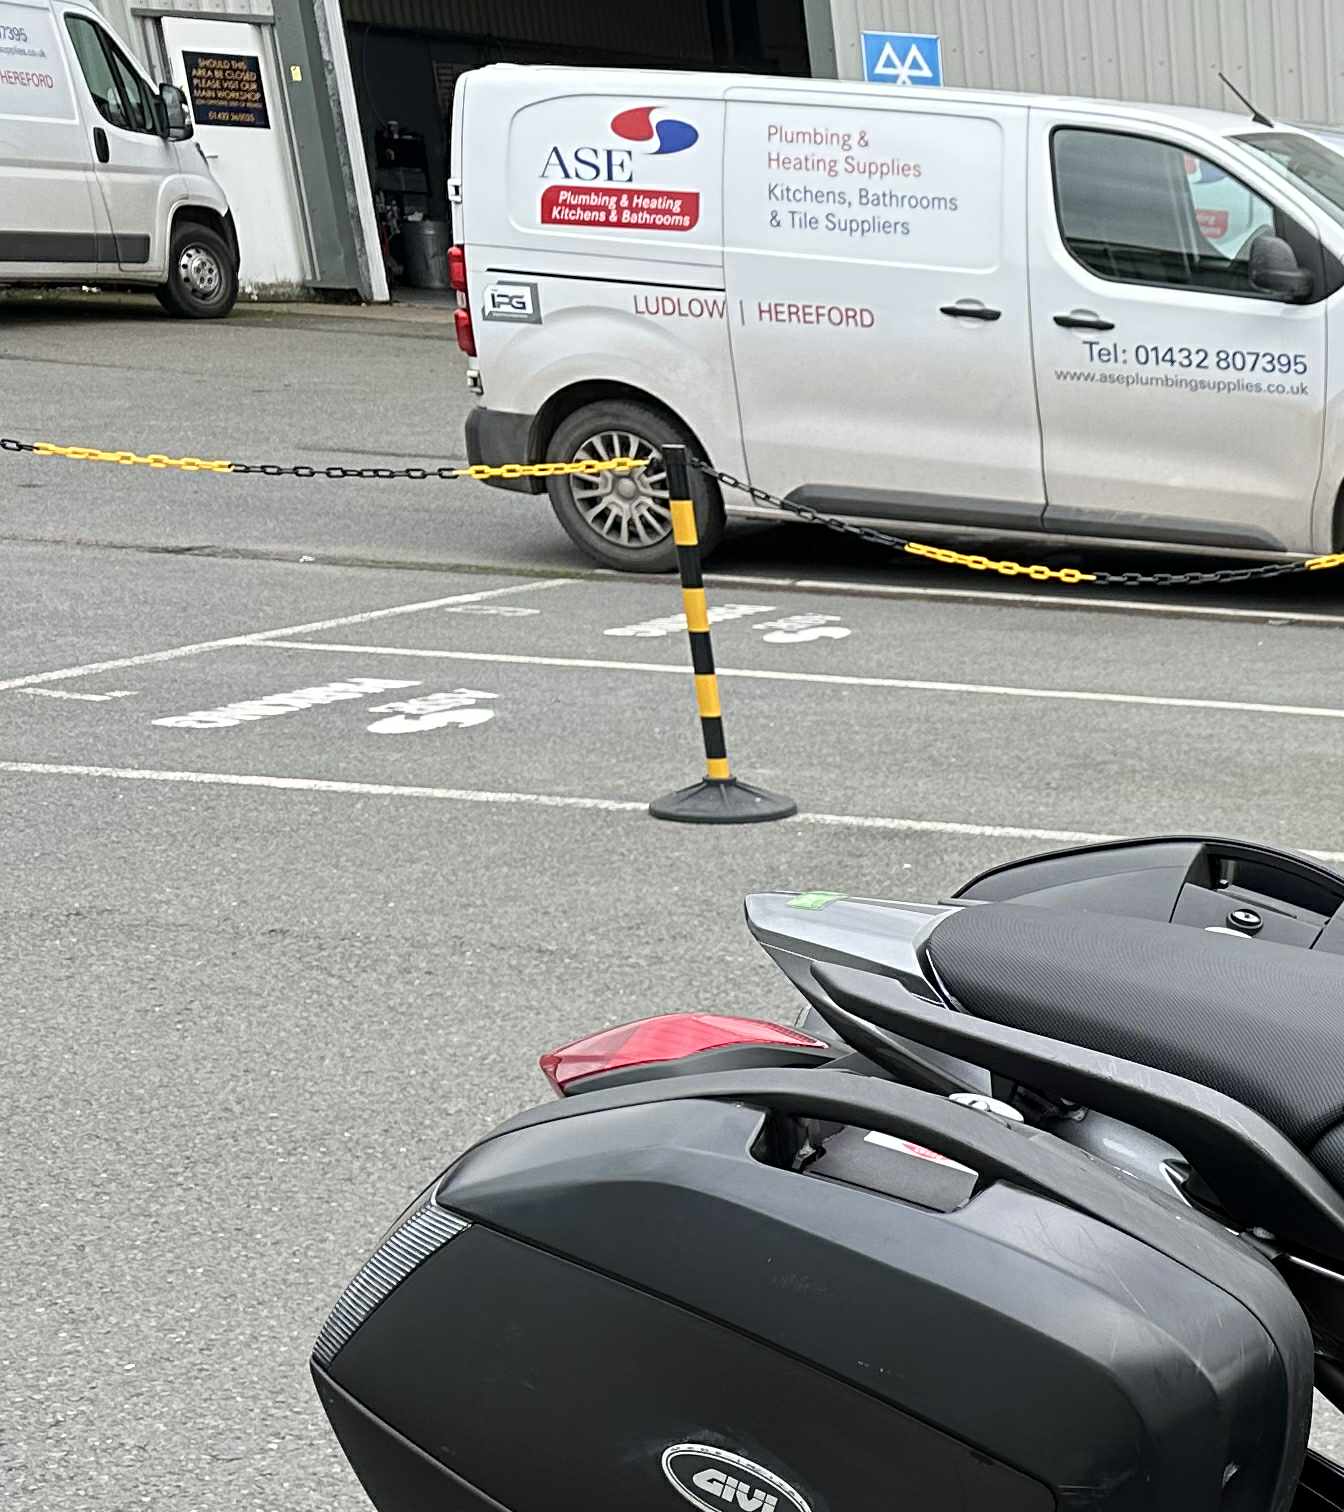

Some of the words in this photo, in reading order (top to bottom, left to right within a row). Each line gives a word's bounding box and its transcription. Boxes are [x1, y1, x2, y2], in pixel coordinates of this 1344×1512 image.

[0, 25, 28, 42] 7395
[768, 125, 852, 152] Plumbing
[857, 130, 869, 148] &
[538, 146, 633, 183] ASE
[768, 152, 838, 178] Heating
[844, 155, 922, 178] Supplies
[558, 190, 617, 210] Plumbing
[620, 194, 629, 204] &
[632, 195, 683, 213] Heating
[768, 183, 852, 208] Kitchens,
[858, 188, 959, 212] Bathrooms
[552, 206, 606, 222] Kitchens
[609, 211, 618, 223] &
[622, 210, 690, 227] Bathrooms
[769, 210, 781, 228] &
[788, 211, 818, 231] Tile
[825, 213, 910, 237] Suppliers
[634, 295, 727, 319] LUDLOW
[758, 302, 876, 328] HEREFORD
[1083, 340, 1128, 365] Tel:
[1135, 344, 1209, 370] 01432
[1216, 350, 1309, 375] 807395
[1054, 368, 1309, 396] www.aseplumbingsupplies.co.uk
